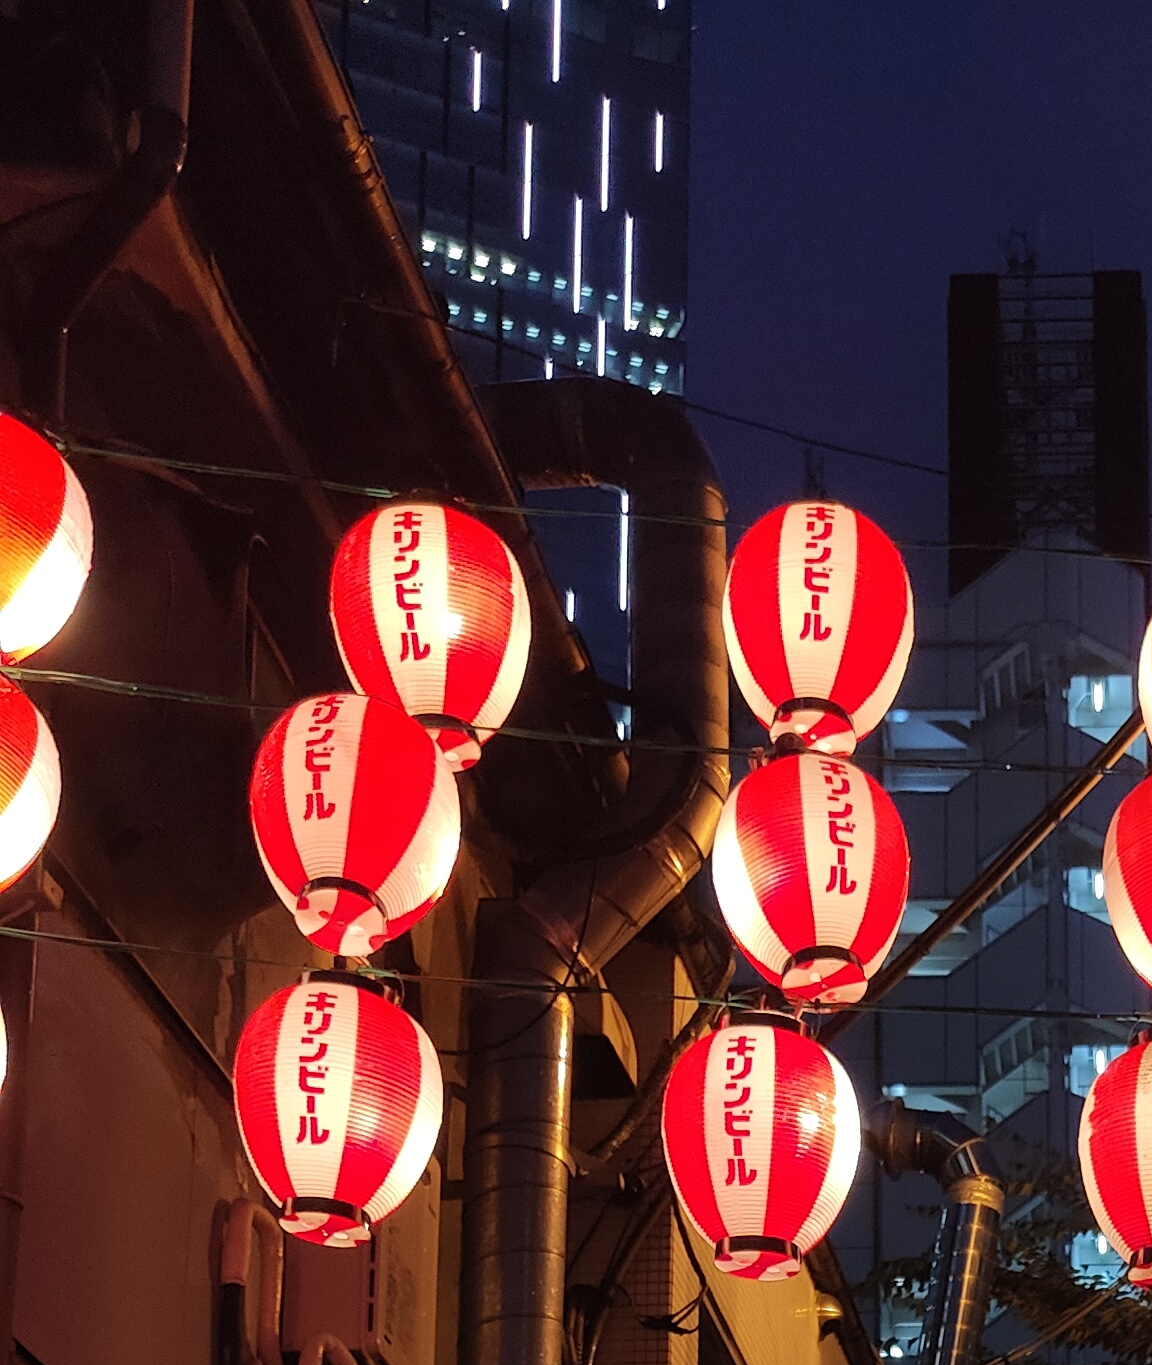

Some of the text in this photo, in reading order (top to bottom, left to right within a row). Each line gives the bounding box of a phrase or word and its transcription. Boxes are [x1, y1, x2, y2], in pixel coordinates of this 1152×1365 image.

[392, 510, 432, 663] キリンビール
[798, 504, 836, 643] キリンビール
[303, 694, 347, 822] キリンビール
[817, 758, 858, 896] キリンビール
[296, 990, 339, 1146] キリンビール
[725, 1035, 758, 1187] キリンビール
